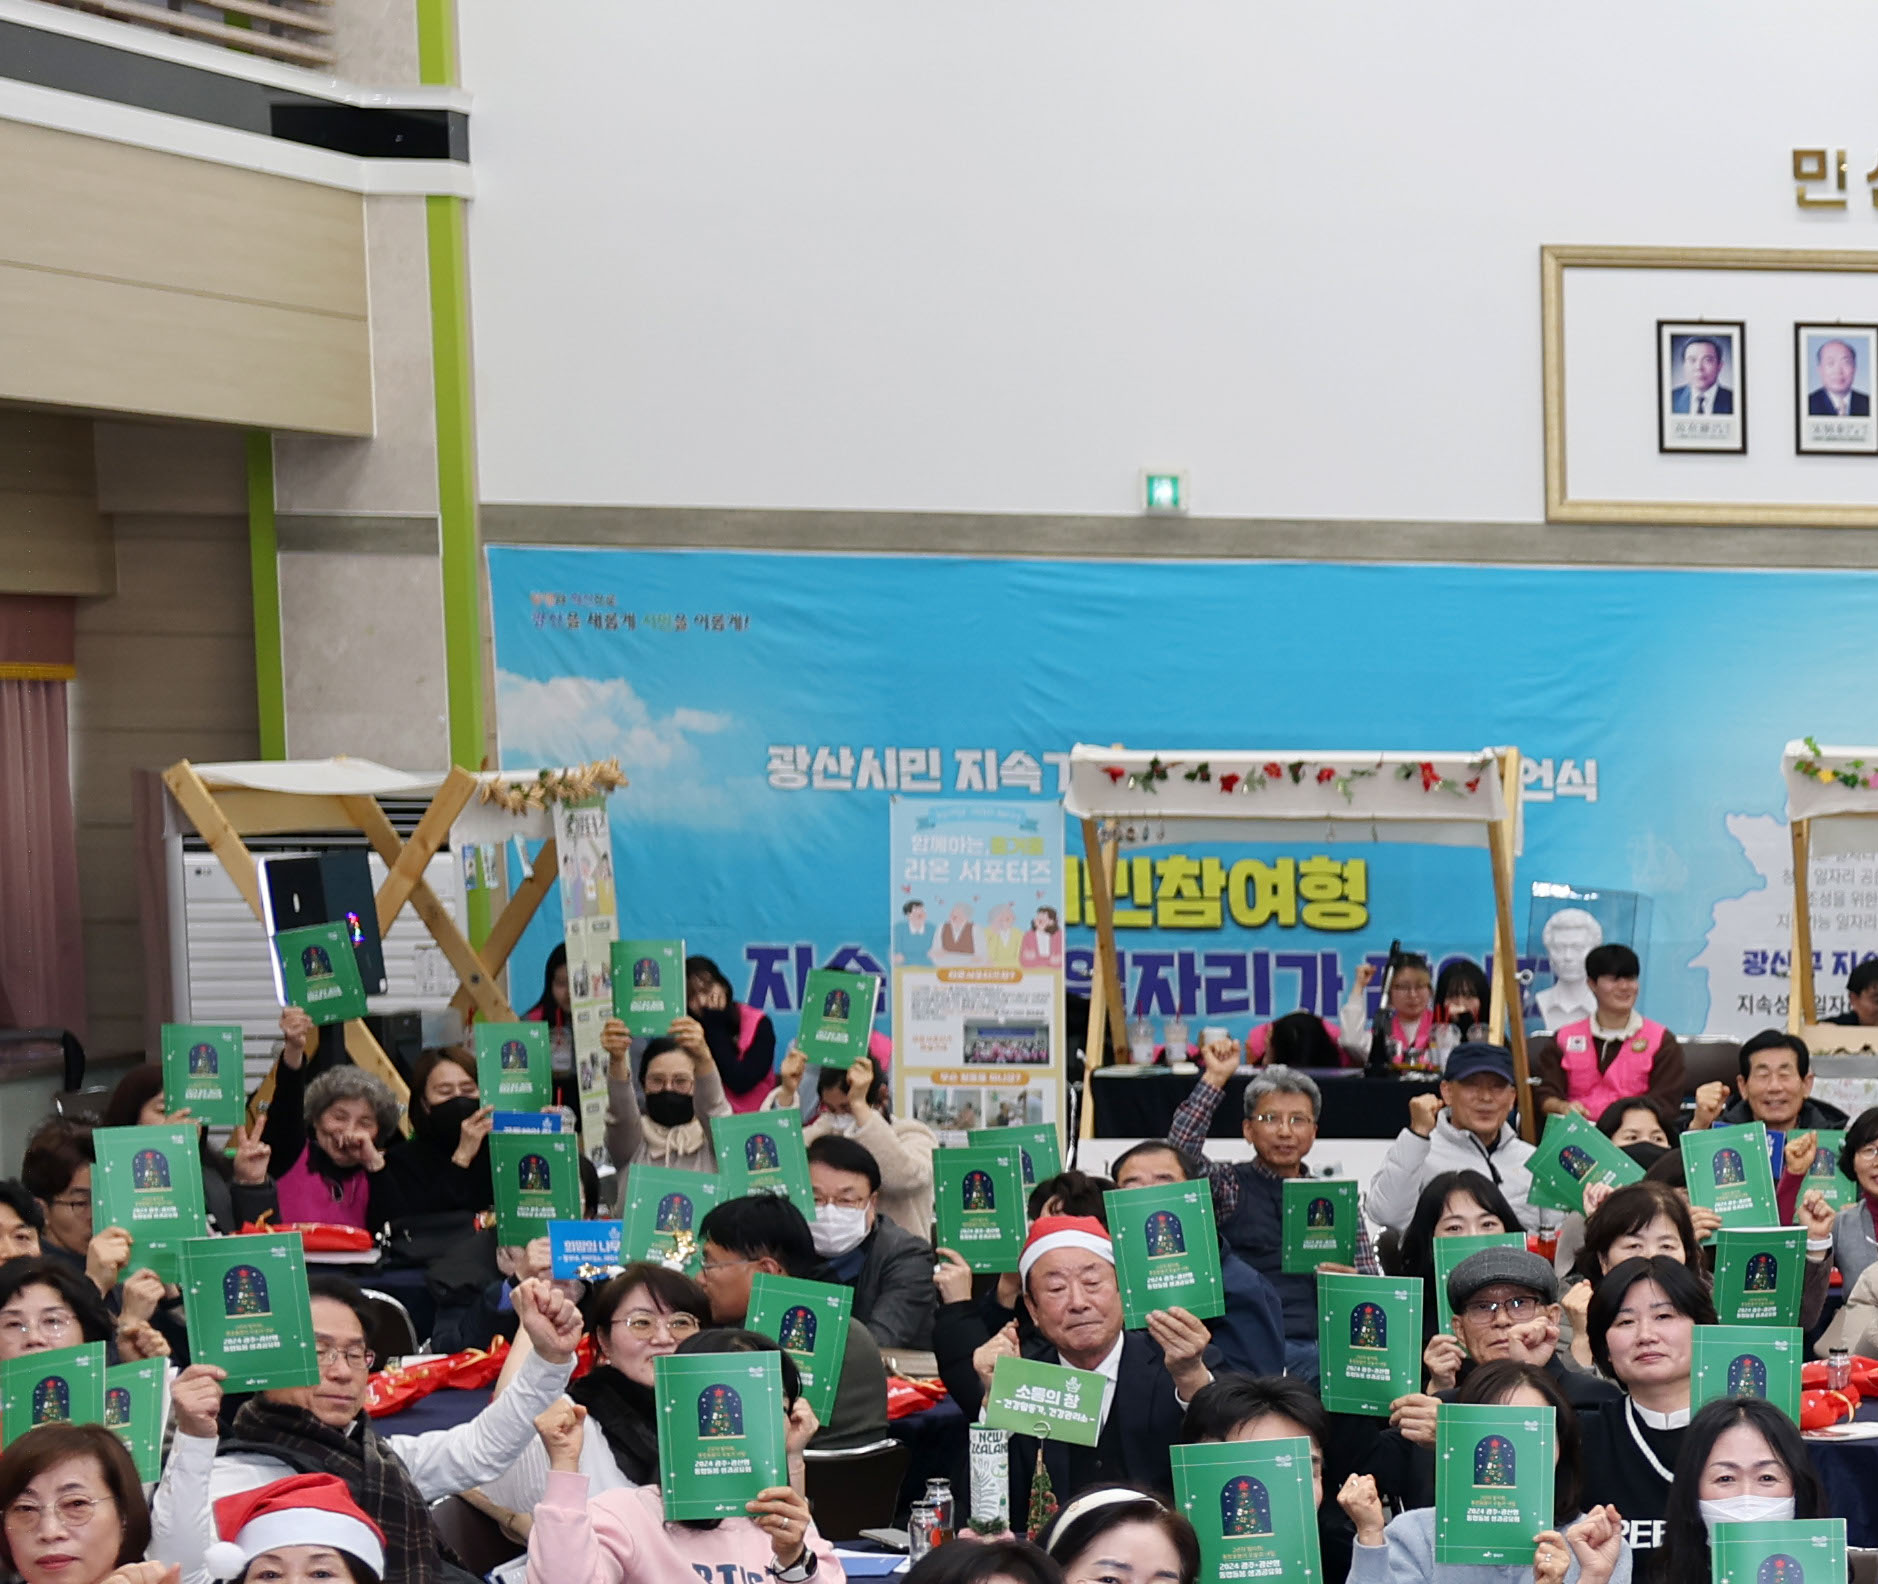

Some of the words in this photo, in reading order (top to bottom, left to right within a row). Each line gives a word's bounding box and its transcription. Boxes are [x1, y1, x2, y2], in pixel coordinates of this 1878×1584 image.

[765, 745, 942, 793] 광산시민
[959, 859, 1052, 884] 서포터즈
[979, 1432, 1002, 1442] NEW
